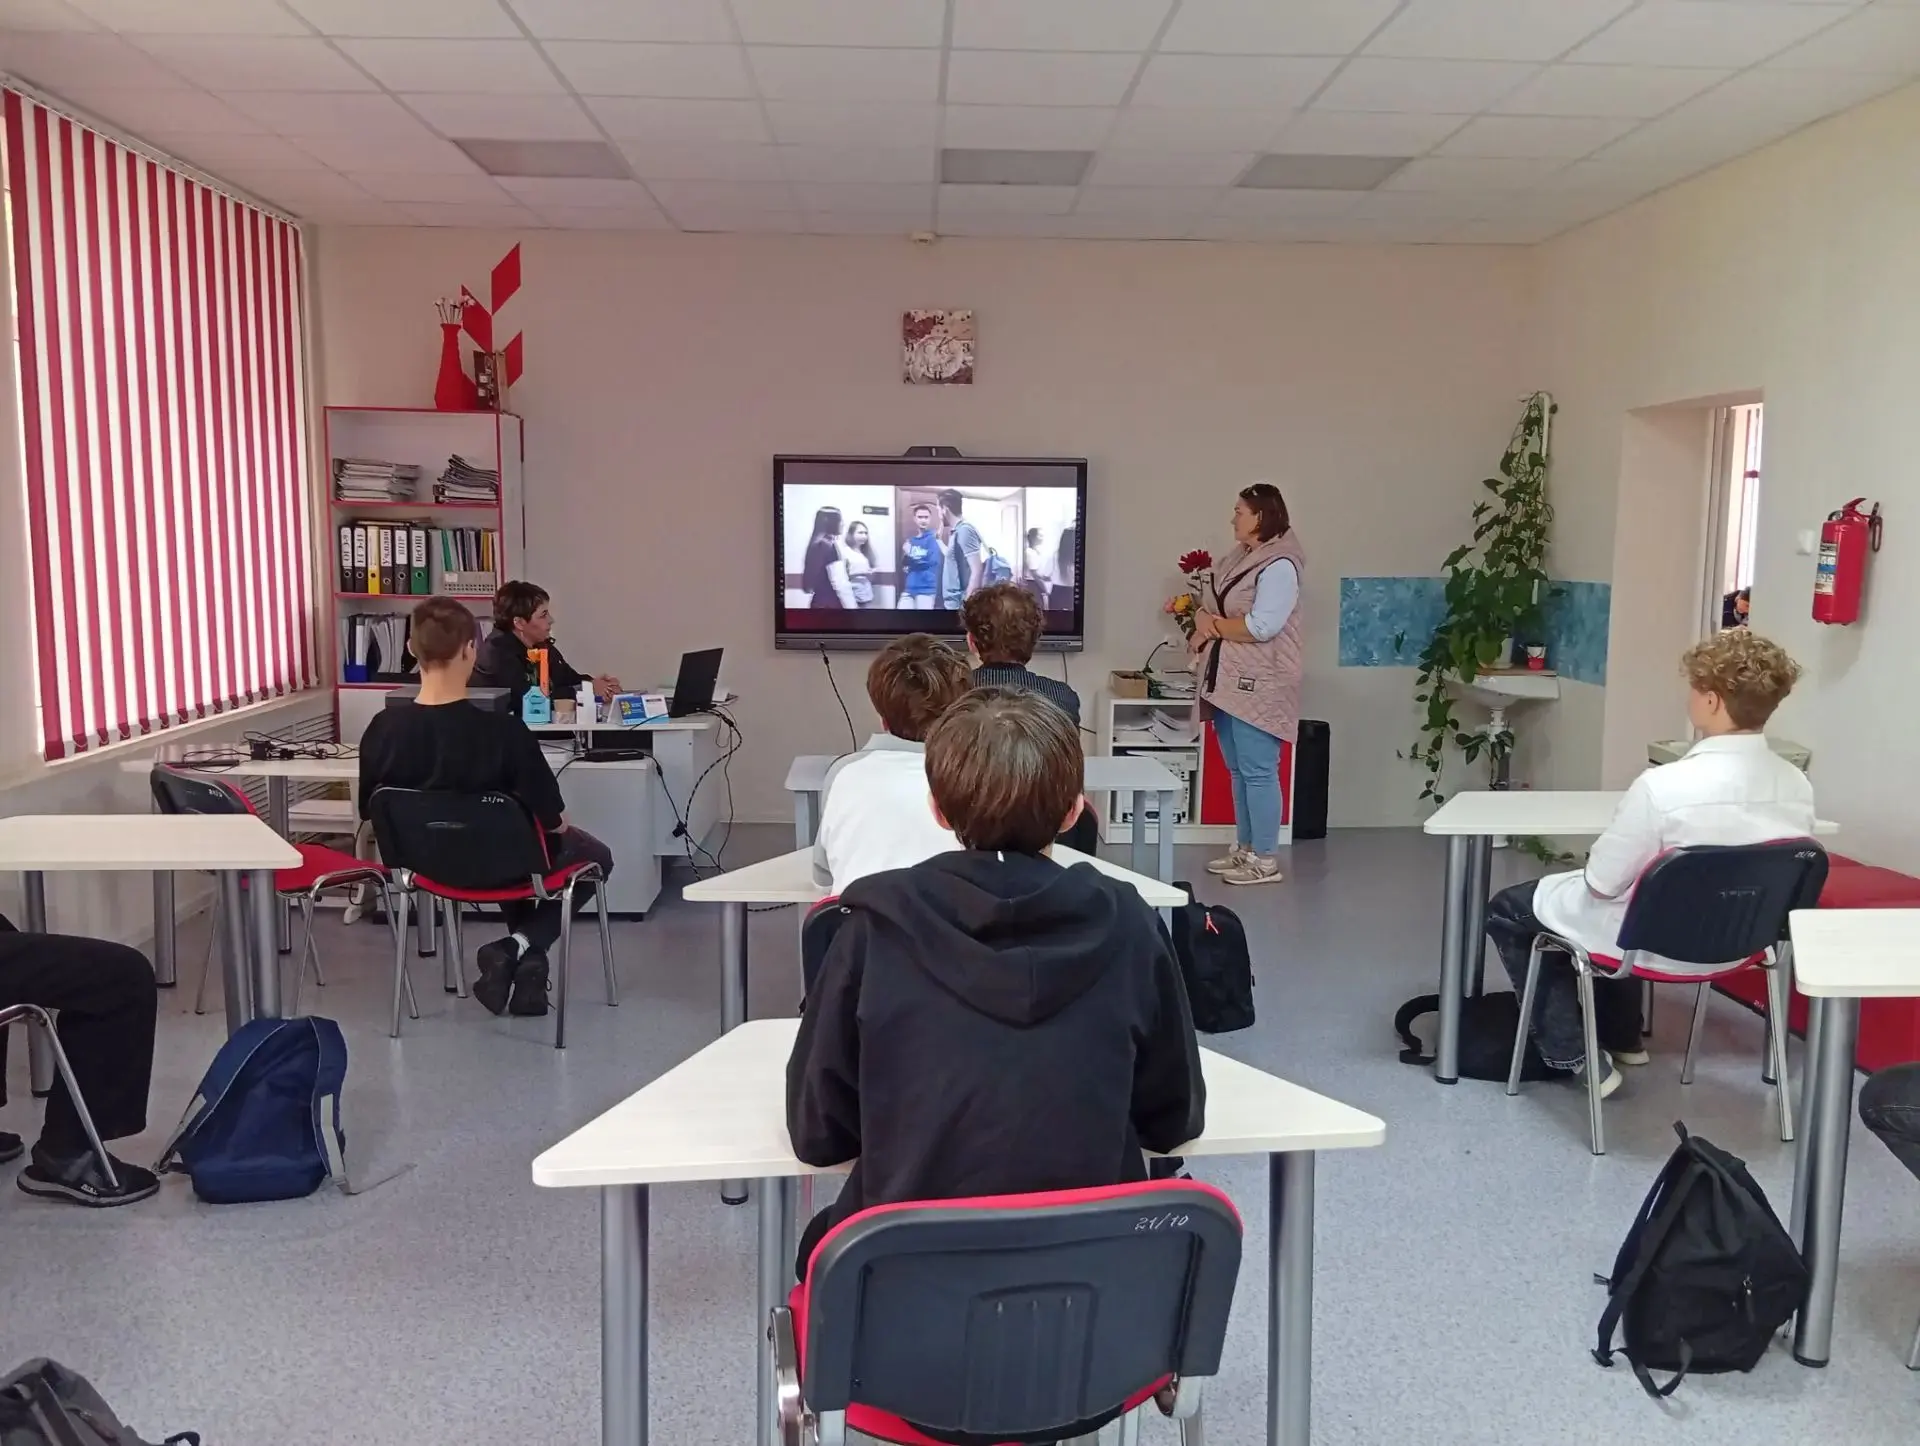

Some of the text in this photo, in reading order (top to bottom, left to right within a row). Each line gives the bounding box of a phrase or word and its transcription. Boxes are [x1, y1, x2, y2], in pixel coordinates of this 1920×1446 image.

[933, 315, 945, 325] 12
[962, 343, 970, 353] 3
[1134, 1212, 1189, 1231] 21/10
